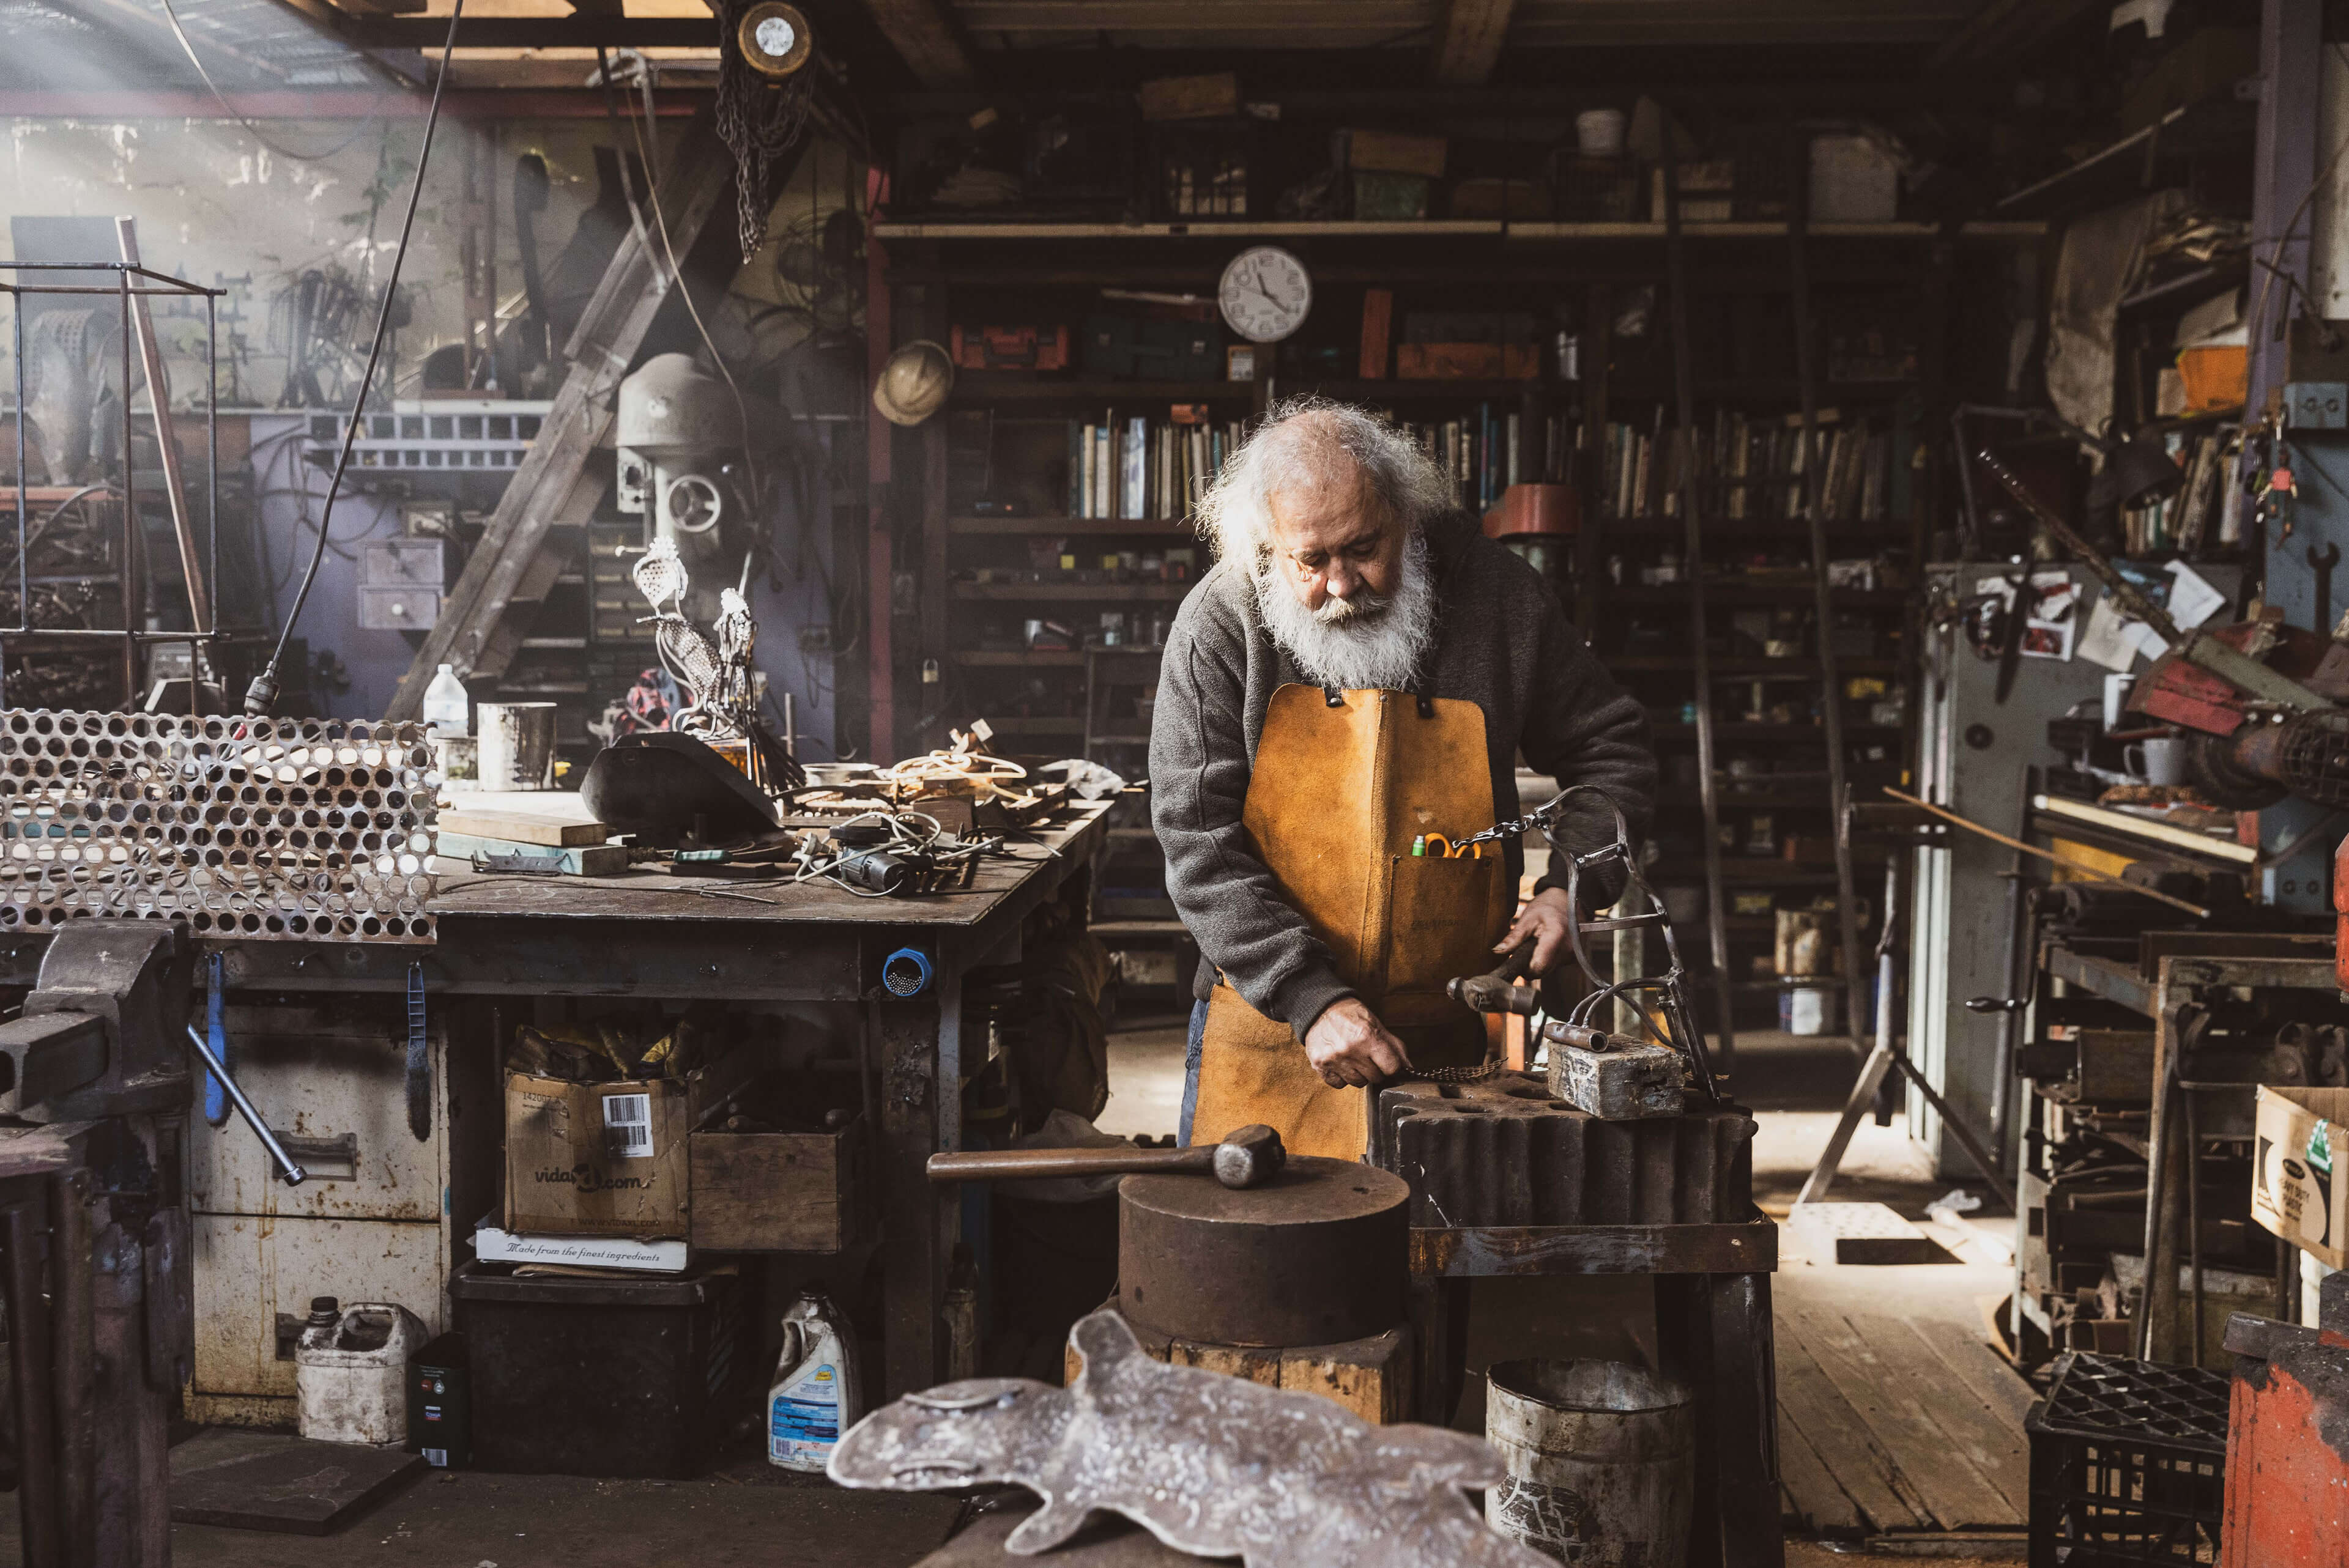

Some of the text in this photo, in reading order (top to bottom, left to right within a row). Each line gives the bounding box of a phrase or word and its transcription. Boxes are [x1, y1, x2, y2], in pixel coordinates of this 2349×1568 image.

[1286, 270, 1299, 285] 2
[1291, 286, 1305, 301] 3
[506, 1242, 660, 1262] Made from the finest ingredients
